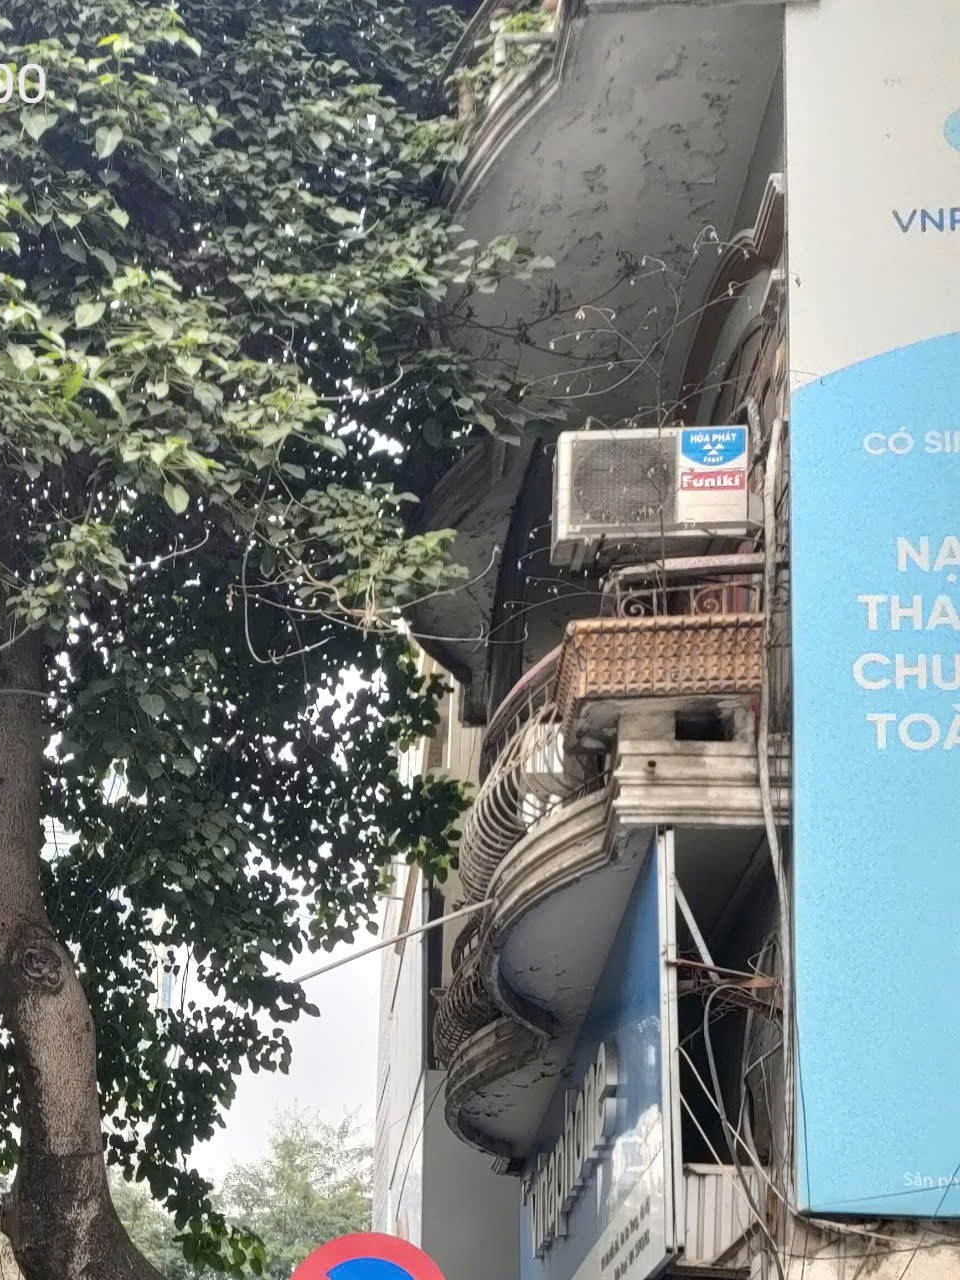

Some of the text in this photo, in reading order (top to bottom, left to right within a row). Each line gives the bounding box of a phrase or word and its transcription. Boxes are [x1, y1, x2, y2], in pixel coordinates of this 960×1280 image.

[689, 430, 737, 443] HÒA PHÁT
[863, 426, 914, 456] CÓ
[682, 474, 740, 489] Funiki
[903, 1170, 933, 1188] Sản
